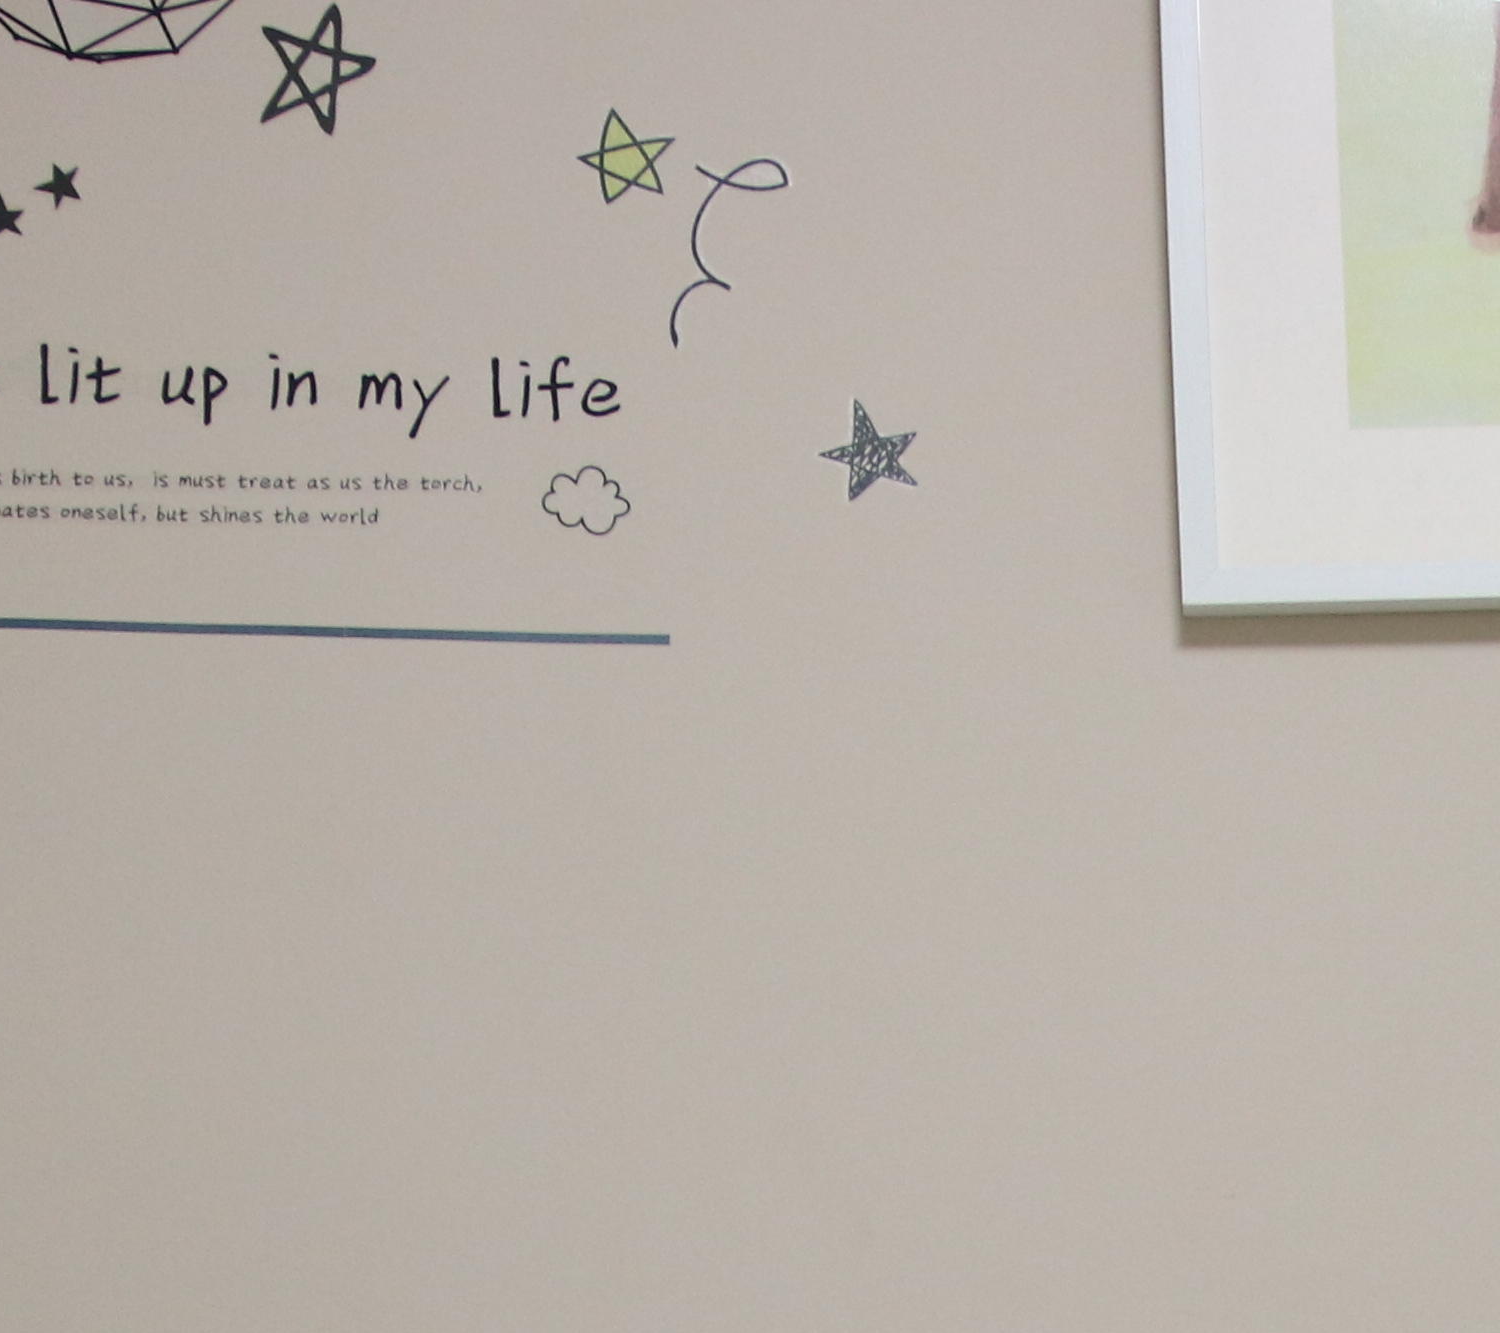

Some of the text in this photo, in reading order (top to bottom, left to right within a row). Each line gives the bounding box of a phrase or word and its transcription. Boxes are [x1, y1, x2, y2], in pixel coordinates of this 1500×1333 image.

[39, 342, 122, 406] lit
[160, 365, 229, 427] up
[268, 352, 318, 412] in
[357, 371, 451, 440] my
[490, 355, 622, 423] life
[11, 467, 62, 487] birth
[72, 471, 95, 487] to
[104, 473, 134, 489] us,
[153, 470, 169, 488] is
[178, 474, 227, 490] must
[237, 474, 297, 491] treat
[306, 477, 331, 491] as
[339, 477, 362, 491] us
[372, 472, 409, 491] the
[419, 473, 483, 494] torch,
[59, 502, 147, 523] oneself,
[156, 504, 189, 523] but
[198, 505, 263, 524] shines
[273, 506, 310, 525] the
[320, 507, 380, 526] world
